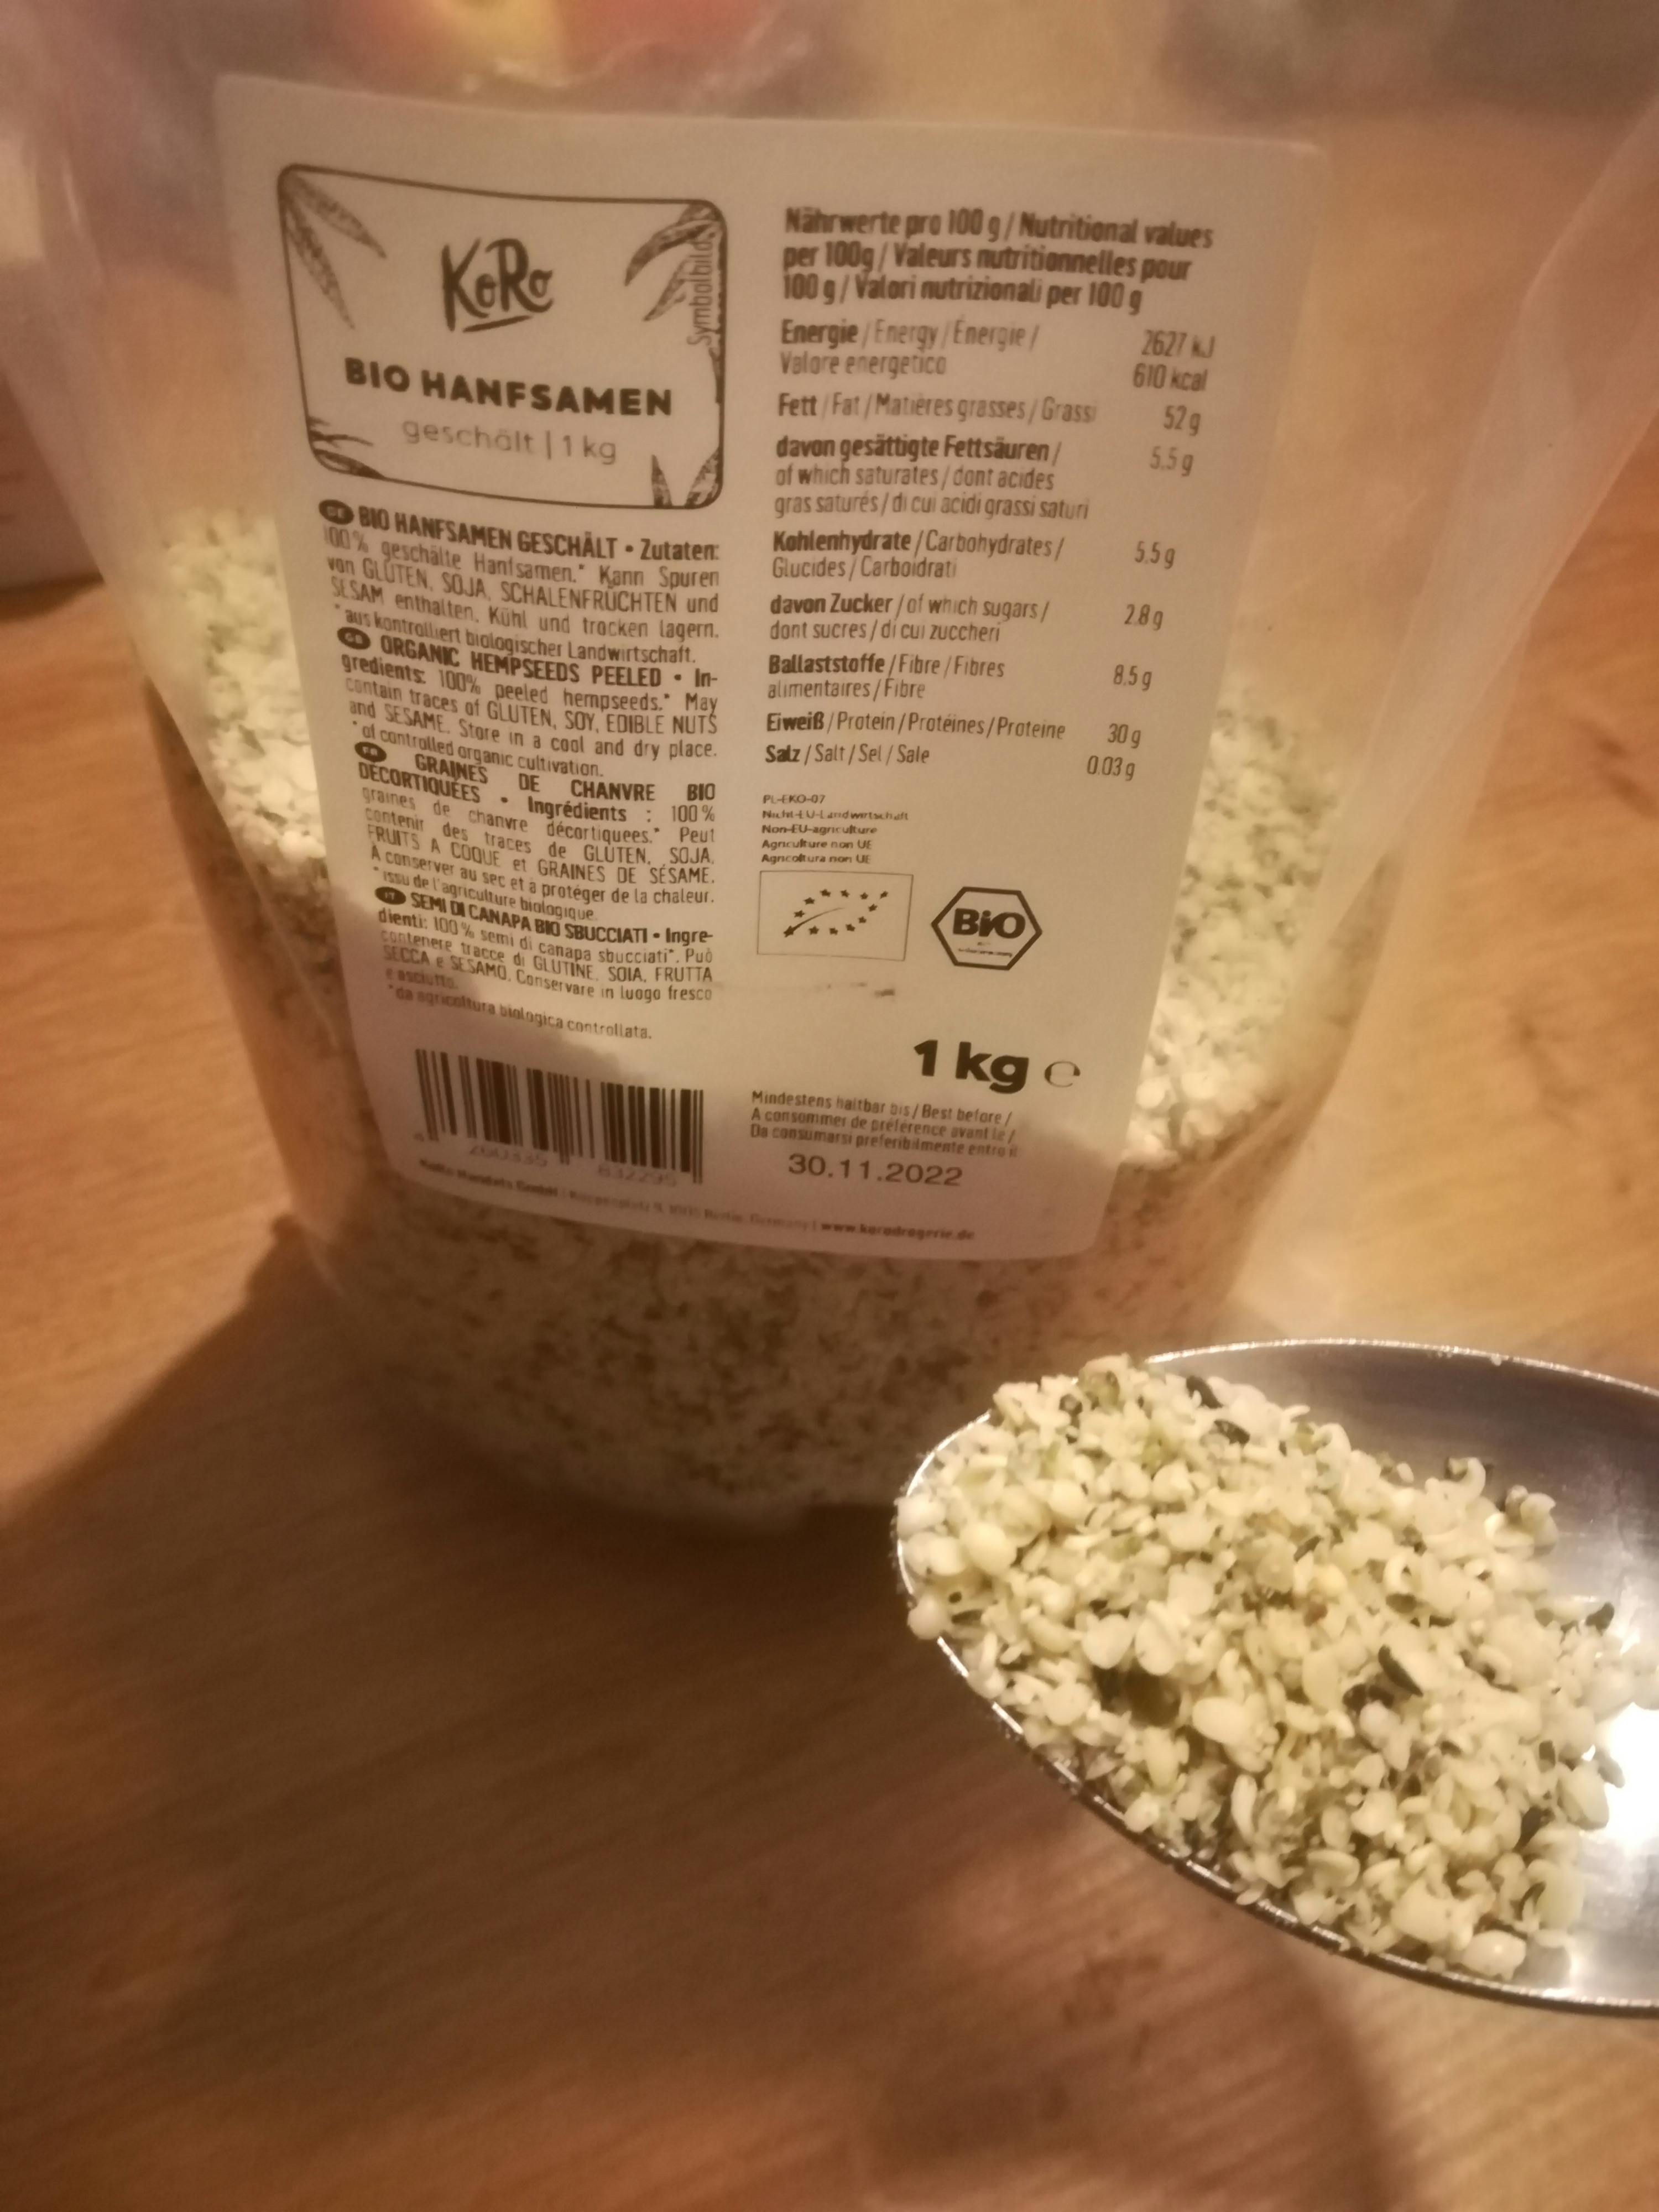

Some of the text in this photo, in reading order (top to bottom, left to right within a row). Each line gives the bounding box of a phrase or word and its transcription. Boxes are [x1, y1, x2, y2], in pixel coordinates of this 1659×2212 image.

[785, 206, 1215, 249] Nährwerte pro 100 Nutritional values
[782, 241, 1194, 284] per Valeurs nutritionnelles pour
[686, 237, 713, 347] Symbolbild
[783, 273, 1144, 317] 100 Valori nutrizionali per 100 g
[781, 318, 859, 349] Energie
[1140, 328, 1188, 357] 2627
[345, 357, 672, 416] BIO HANFSAMEN
[1133, 362, 1208, 392] 610 kcal
[777, 392, 1026, 423] Fett Fat grasses
[1163, 404, 1202, 437] 52 g
[403, 419, 617, 465] geschält 1 kg
[776, 433, 1050, 462] davon gesättigte Fettsäuren
[776, 463, 1055, 491] of which saturates acides
[1180, 453, 1194, 477] g
[774, 491, 1091, 520] gras acidi grassi saturi
[358, 505, 390, 531] BIO
[395, 512, 512, 550] HANFSAMEN
[773, 529, 1053, 558] Kohlenhydrate Carbohydrates
[1134, 540, 1176, 570] 5.5 g
[599, 565, 719, 590] Kann Spuren
[773, 555, 958, 578] Glucides Carboidrati
[687, 592, 719, 613] und
[770, 593, 1039, 625] davon Zucker of which sugars
[539, 612, 719, 643] und trocken lagern.
[770, 619, 1000, 642] dont sucres di zuccheri
[1152, 610, 1164, 632] g
[380, 634, 460, 667] ORGANIC
[471, 651, 580, 682] HEMPSEEDS
[591, 665, 662, 687] PEELED
[694, 667, 718, 688] In-
[567, 640, 696, 664] Landwirtschaft.
[768, 653, 1005, 678] Ballaststoffe Fibre Fibres
[768, 677, 926, 699] alimentaires Fibre
[1113, 664, 1152, 692] 8.5 g
[494, 684, 547, 705] peeled
[685, 692, 718, 716] May
[606, 713, 718, 735] EDIBLE NUTS
[766, 711, 1066, 740] Eiweiß Protein Protéines Proteine
[1107, 723, 1142, 749] 30 g
[509, 732, 717, 762] in cool and dry place.
[764, 743, 930, 764] Salz Salt Sel Sale
[414, 753, 716, 801] GRAINES DE CHANVRE BIO
[1086, 755, 1136, 782] 0.03 g
[528, 795, 627, 822] Ingrédients
[679, 826, 716, 843] Peut
[547, 841, 715, 865] de GLUTEN, SOJA,
[460, 867, 714, 904] au sec de la chaleur.
[513, 858, 637, 885] et GRAINES DE
[411, 891, 714, 947] SEMI CANAPA BIO SBUCCIATI Ingre-
[538, 942, 591, 962] canapa
[516, 969, 712, 1004] Conservare in luogo fresco
[608, 966, 713, 983] SOIA, FRUTTA
[914, 1039, 1029, 1094] 1 kg
[752, 1089, 832, 1109] Mindestens
[921, 1103, 952, 1120] Best
[957, 1108, 1002, 1125] before
[764, 1110, 847, 1128] consommer
[788, 1152, 963, 1187] 30.11.2022
